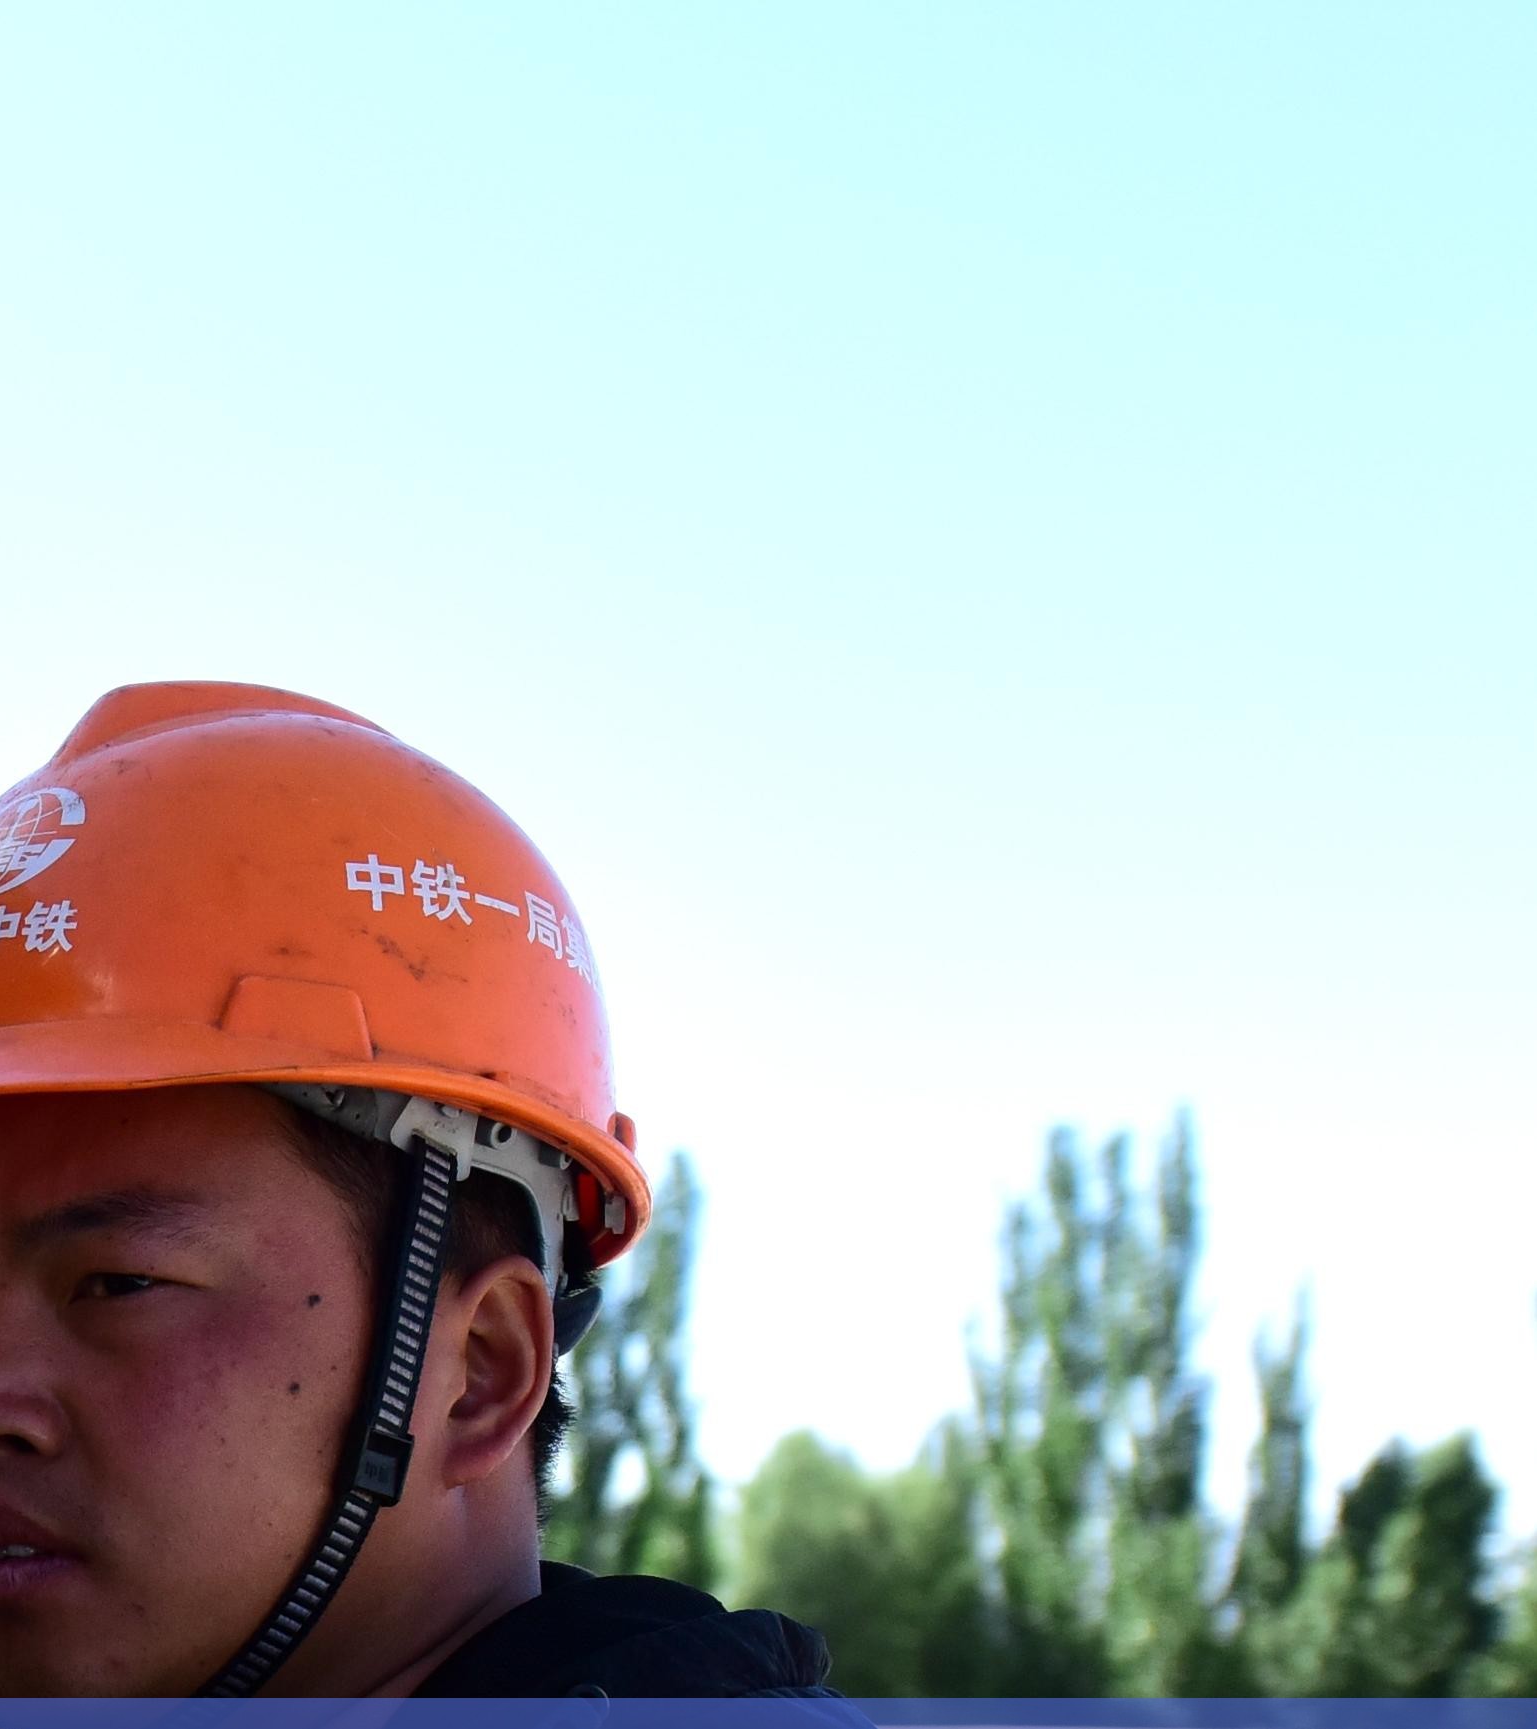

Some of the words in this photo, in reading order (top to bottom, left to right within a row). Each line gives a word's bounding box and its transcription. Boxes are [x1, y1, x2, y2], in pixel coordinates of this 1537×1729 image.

[346, 854, 601, 990] 中铁一局集
